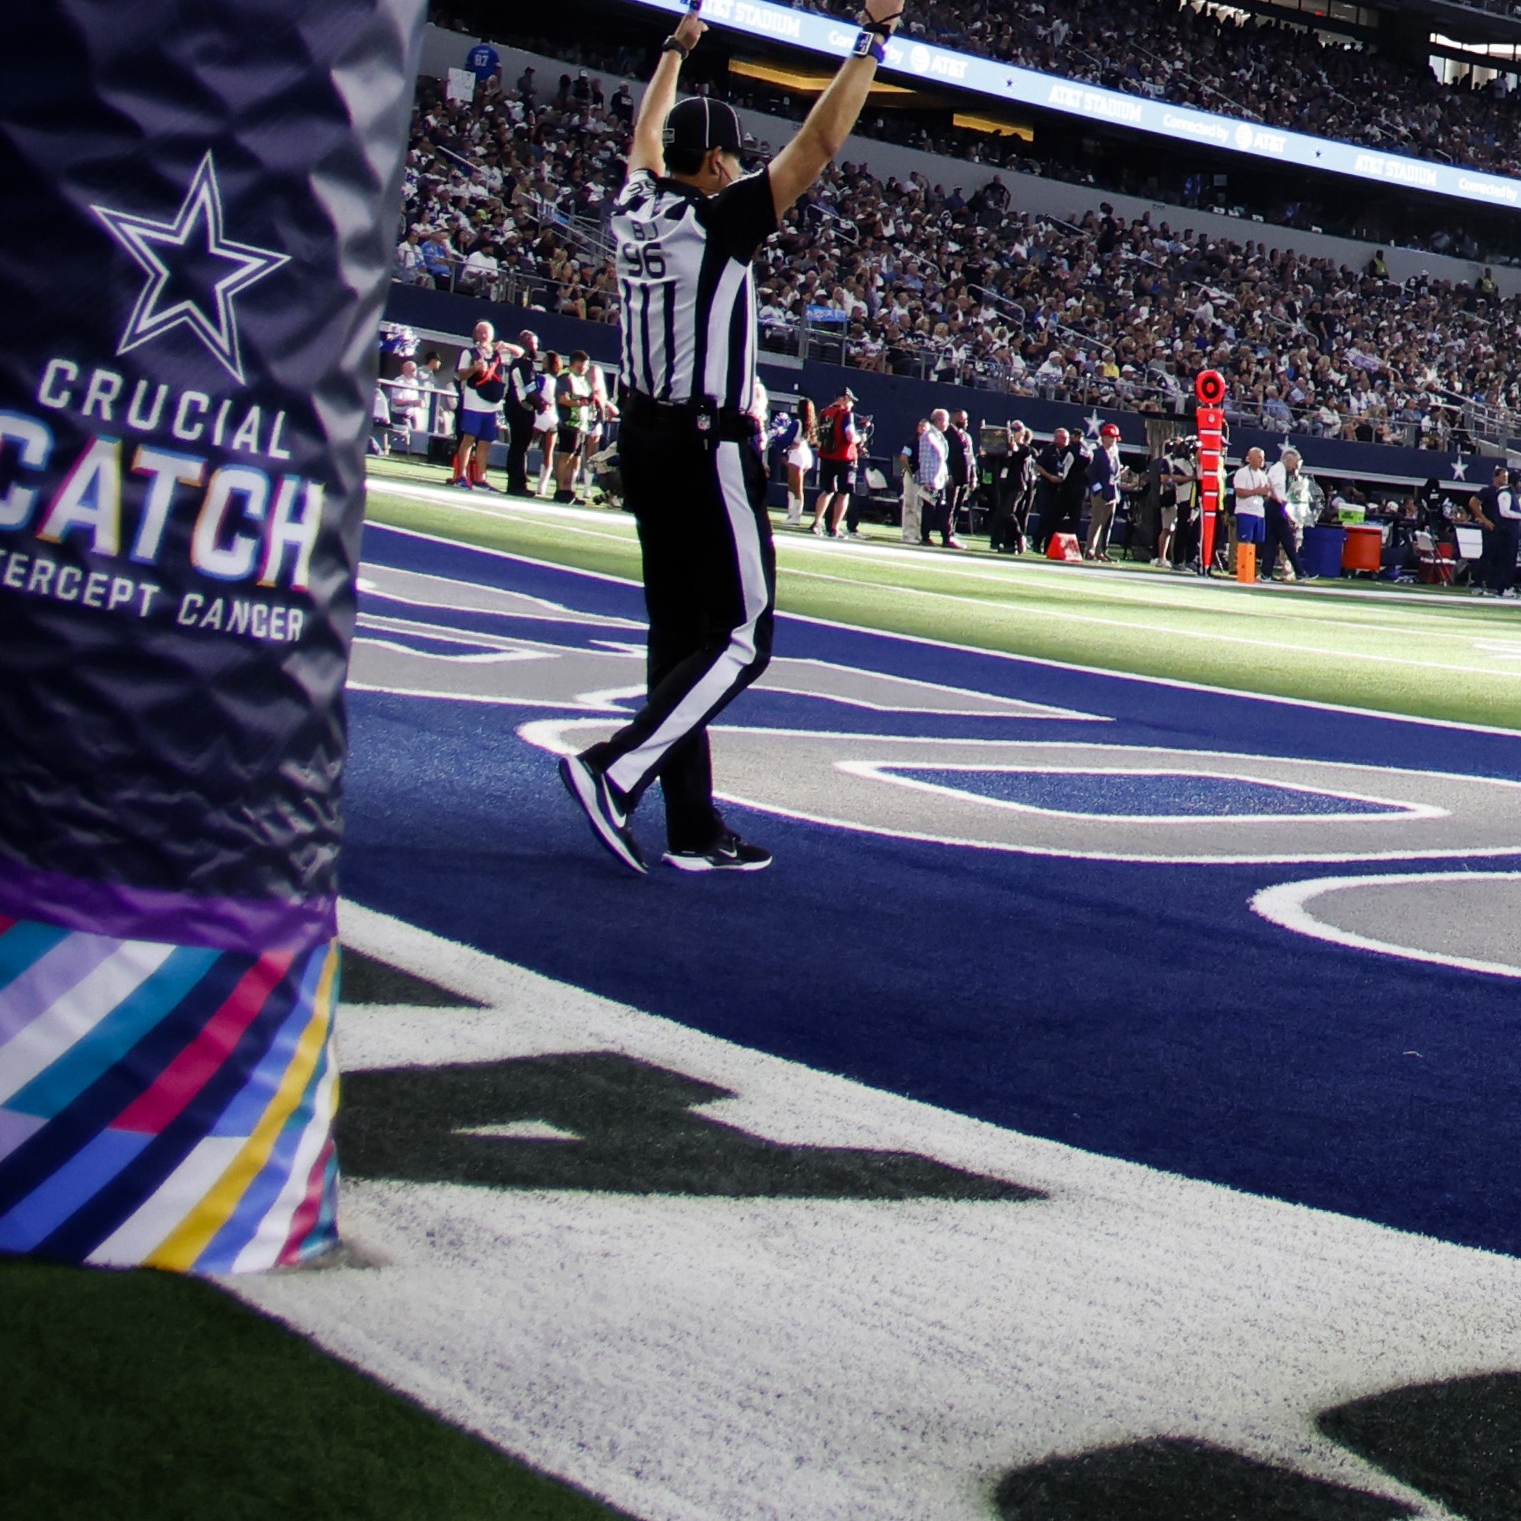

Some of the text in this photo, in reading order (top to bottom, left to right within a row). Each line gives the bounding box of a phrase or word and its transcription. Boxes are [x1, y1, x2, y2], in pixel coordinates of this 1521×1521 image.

[735, 0, 802, 38] STADIUM
[929, 53, 970, 79] AT&T
[1048, 83, 1142, 123] AT&T STADIUM
[1251, 131, 1288, 153] AT&T
[1354, 153, 1438, 187] AT&T STADIUM
[631, 220, 659, 242] BJ
[622, 241, 667, 280] 96
[39, 358, 291, 459] CRUCIAL
[0, 547, 305, 643] ERCEPT CANCER
